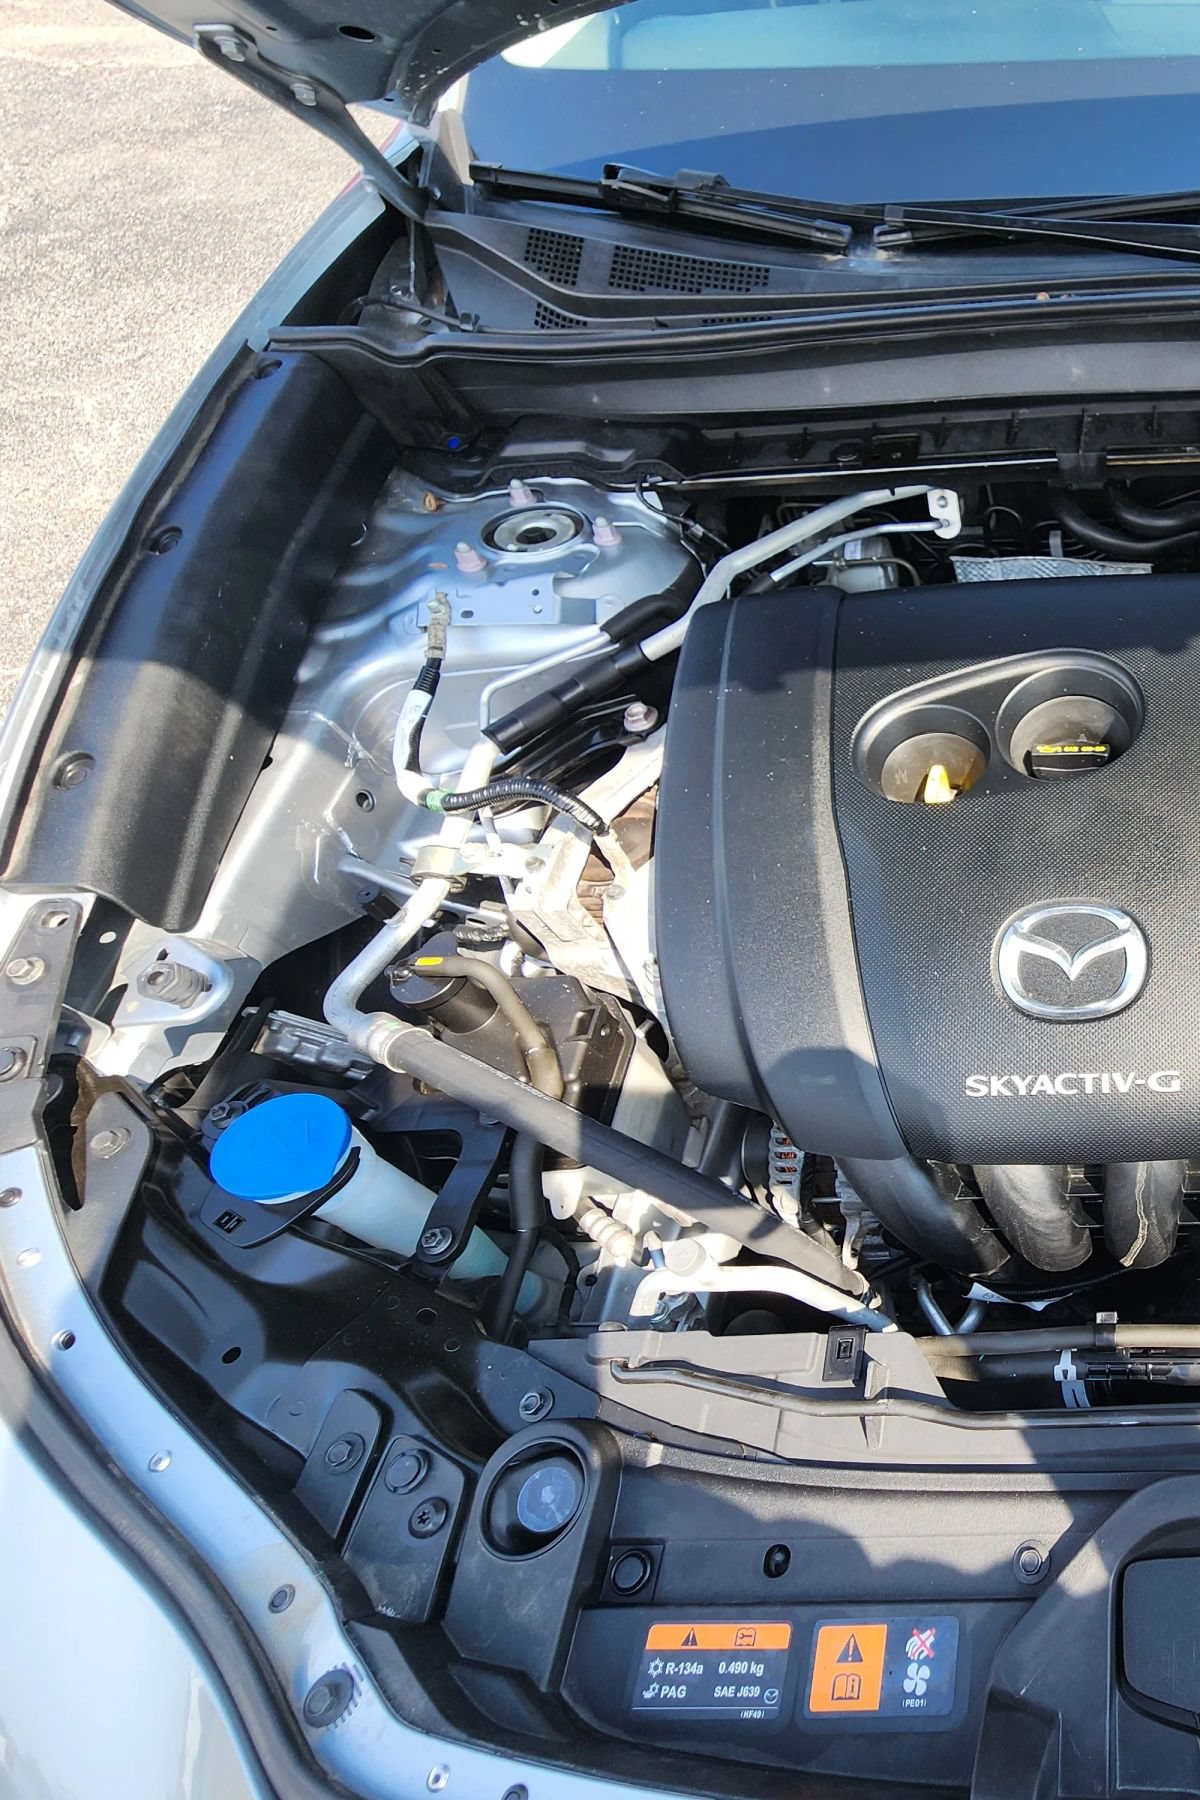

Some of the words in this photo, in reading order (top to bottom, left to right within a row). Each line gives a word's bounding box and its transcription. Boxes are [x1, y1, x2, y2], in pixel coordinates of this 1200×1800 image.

[965, 1070, 1182, 1098] SKYACTIV-G
[665, 1661, 704, 1676] R-134a
[718, 1661, 748, 1675] 0.490
[749, 1660, 765, 1678] kg
[660, 1685, 687, 1699] PAG
[713, 1685, 735, 1698] SAE
[736, 1685, 761, 1698] J639
